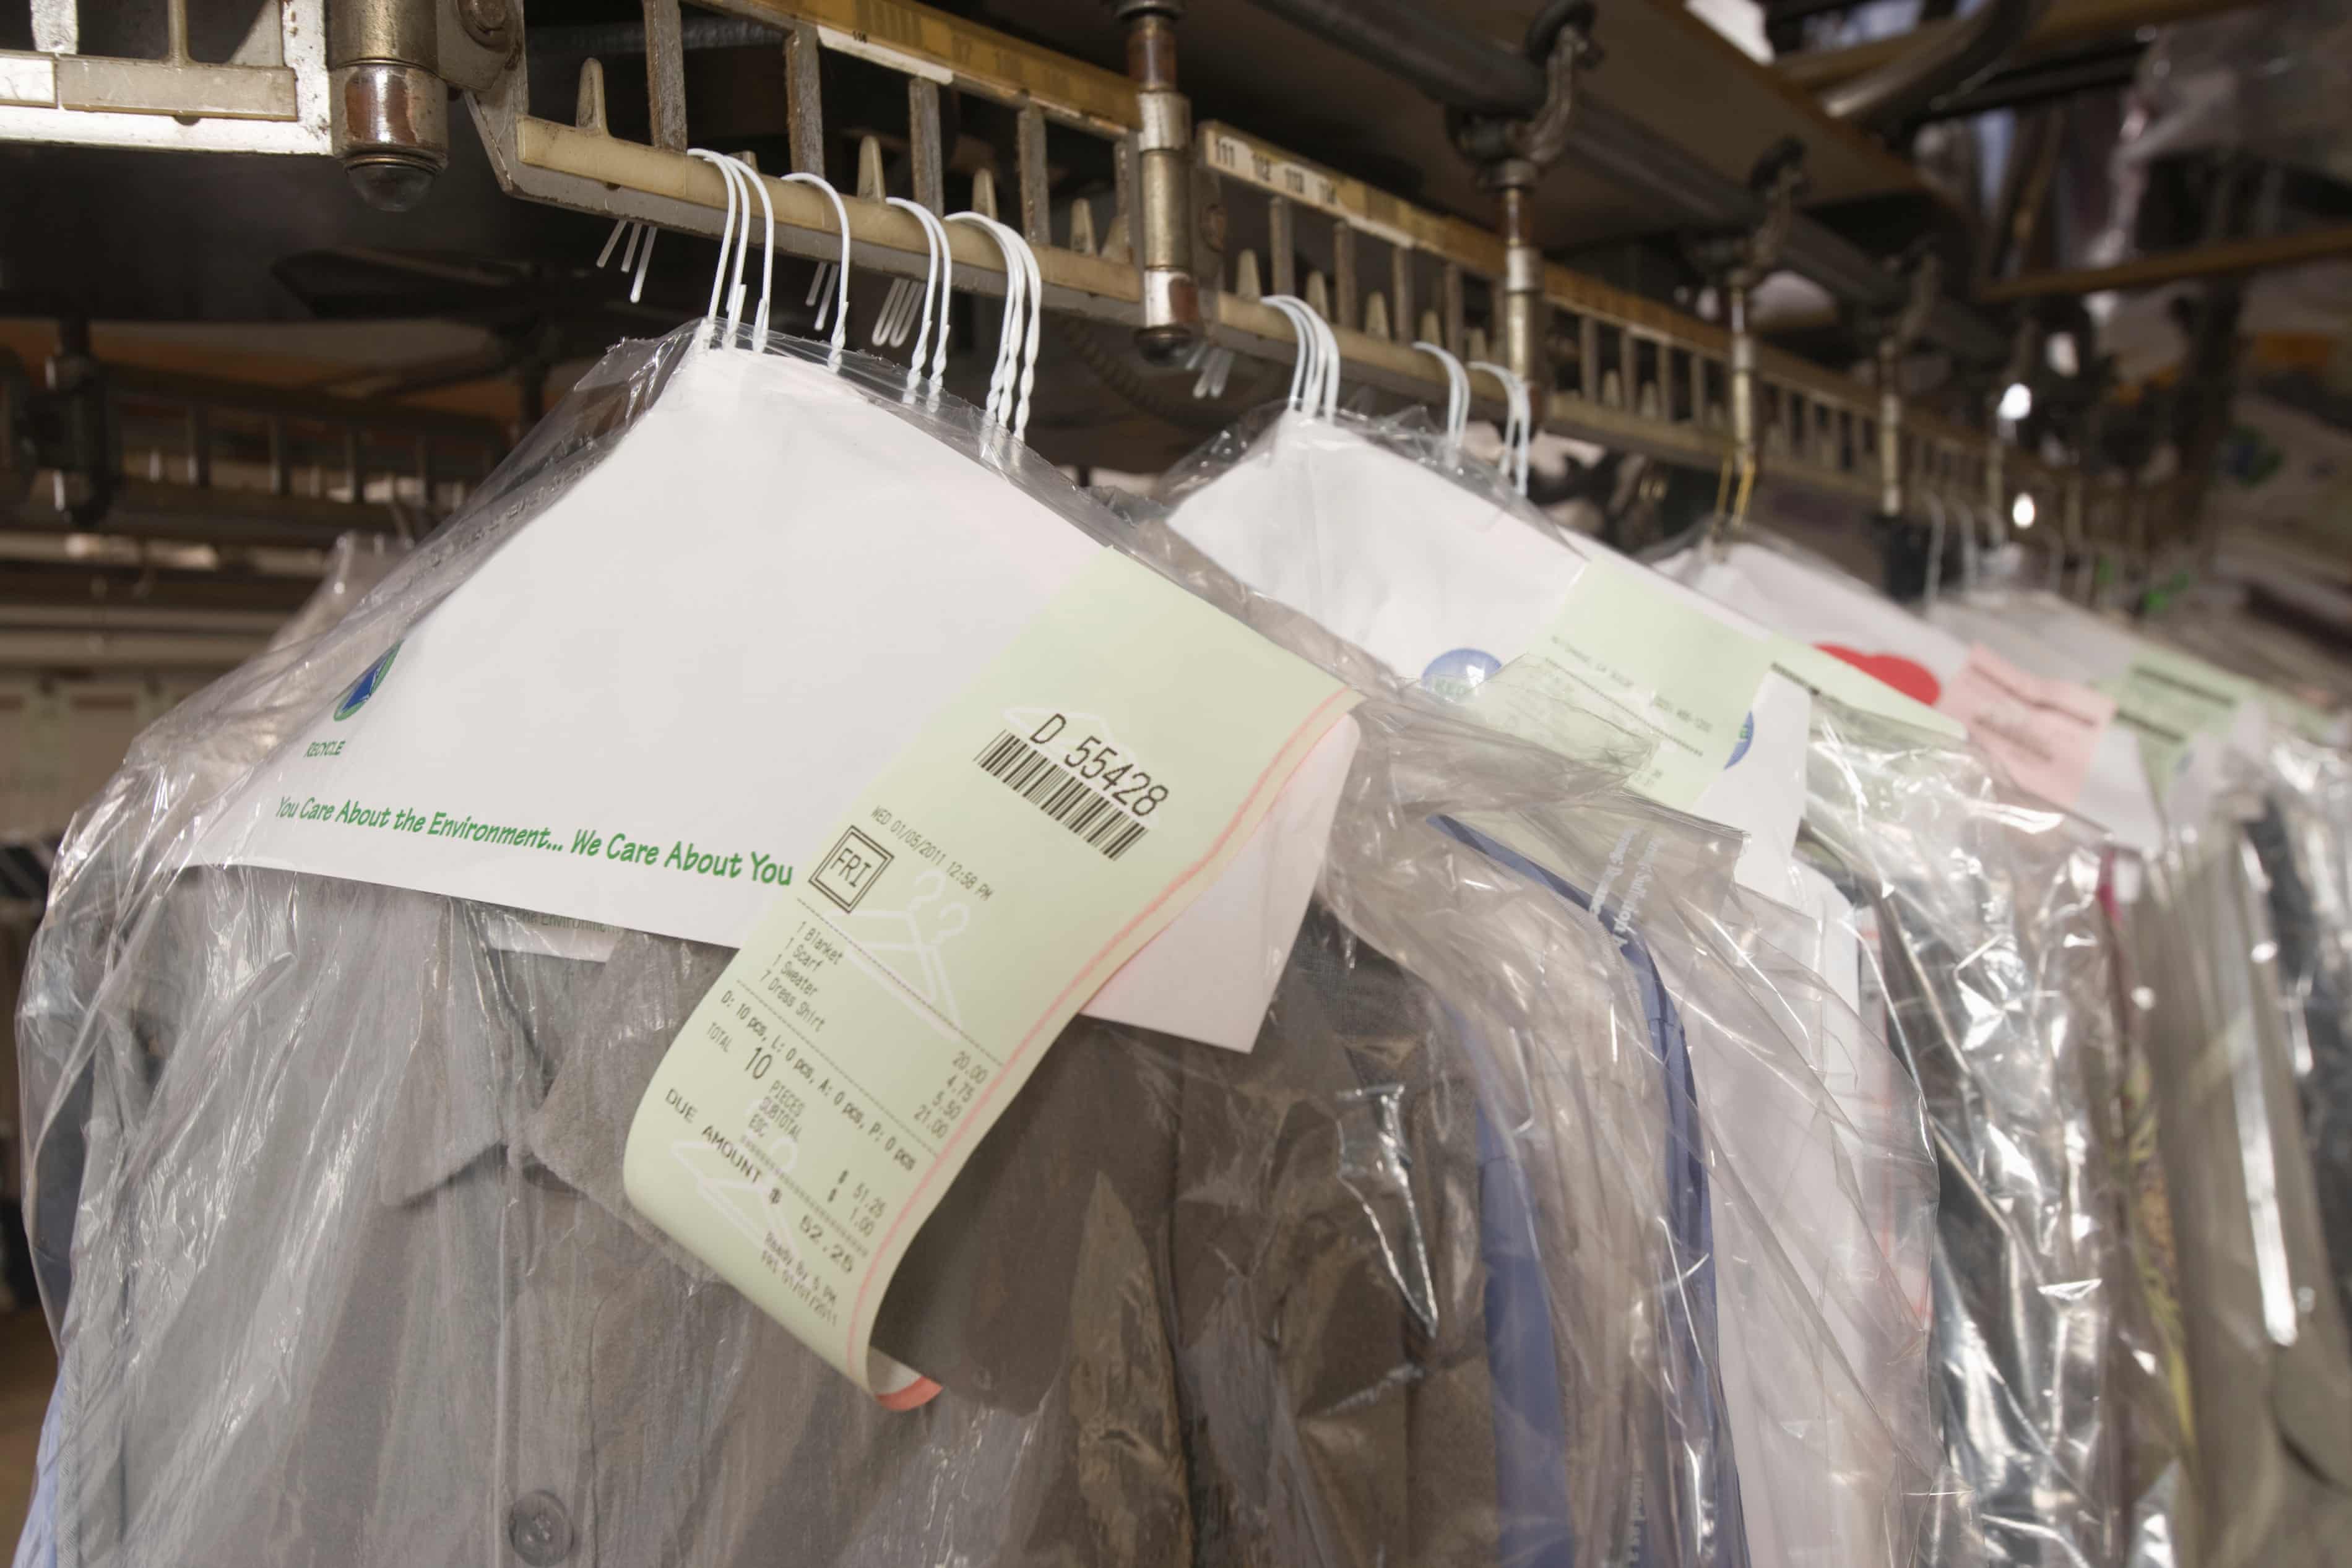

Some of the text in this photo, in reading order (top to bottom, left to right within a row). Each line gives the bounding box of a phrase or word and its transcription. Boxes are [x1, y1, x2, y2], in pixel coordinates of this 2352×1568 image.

[304, 741, 346, 757] RECYCLE
[1029, 713, 1169, 817] D 55428
[276, 796, 793, 885] You Care About the Environment... We Care About You
[830, 846, 872, 889] FRI
[871, 805, 994, 901] WED 01/05/2011 12:58 PM
[760, 969, 949, 1139] 7 Dress Shirt 21.00
[772, 954, 962, 1121] 1 Sweater 5.50
[785, 937, 975, 1103] 1 Scarf 4.75
[797, 921, 988, 1084] 1 Blanket 20.00
[707, 1022, 805, 1117] TOTAL 10 PIECES
[736, 1003, 751, 1020] 10
[771, 1035, 785, 1053] L:
[785, 1047, 797, 1061] 0
[817, 1078, 832, 1096] A:
[834, 1091, 845, 1106] 0
[868, 1121, 884, 1142] P:
[884, 1136, 896, 1151] 0
[893, 1147, 916, 1171] pcs
[665, 1088, 698, 1124] DUE
[701, 1124, 763, 1183] AMOUNT
[800, 1215, 854, 1273] 52.25
[759, 1095, 803, 1144] SUBTOTAL
[853, 1182, 886, 1218] 51.25
